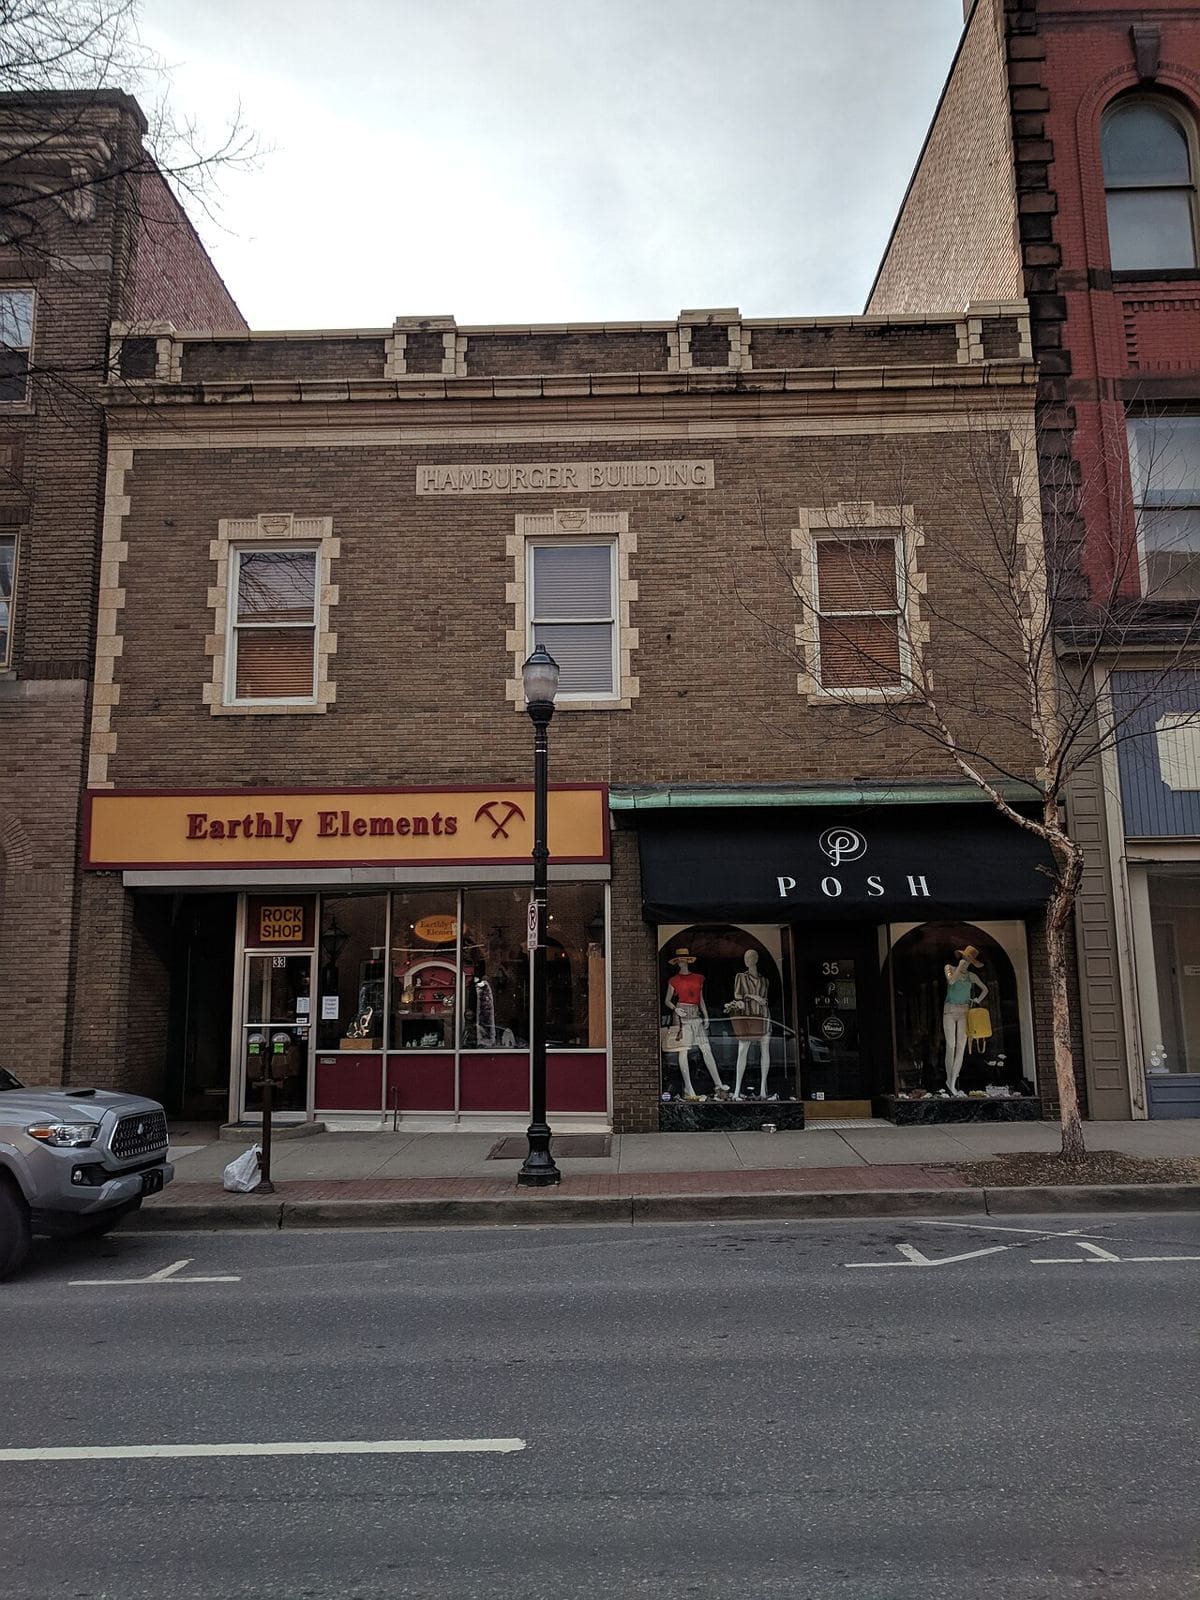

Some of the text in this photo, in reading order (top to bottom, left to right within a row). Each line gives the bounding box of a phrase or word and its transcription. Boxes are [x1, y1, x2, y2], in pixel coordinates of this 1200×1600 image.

[422, 464, 706, 491] HAMBURGER BUILDING
[186, 811, 458, 843] Earthly Elements
[776, 875, 931, 897] POSH
[262, 908, 302, 922] ROCK
[262, 924, 302, 938] SHOP
[273, 956, 286, 968] 33
[822, 962, 840, 975] 35
